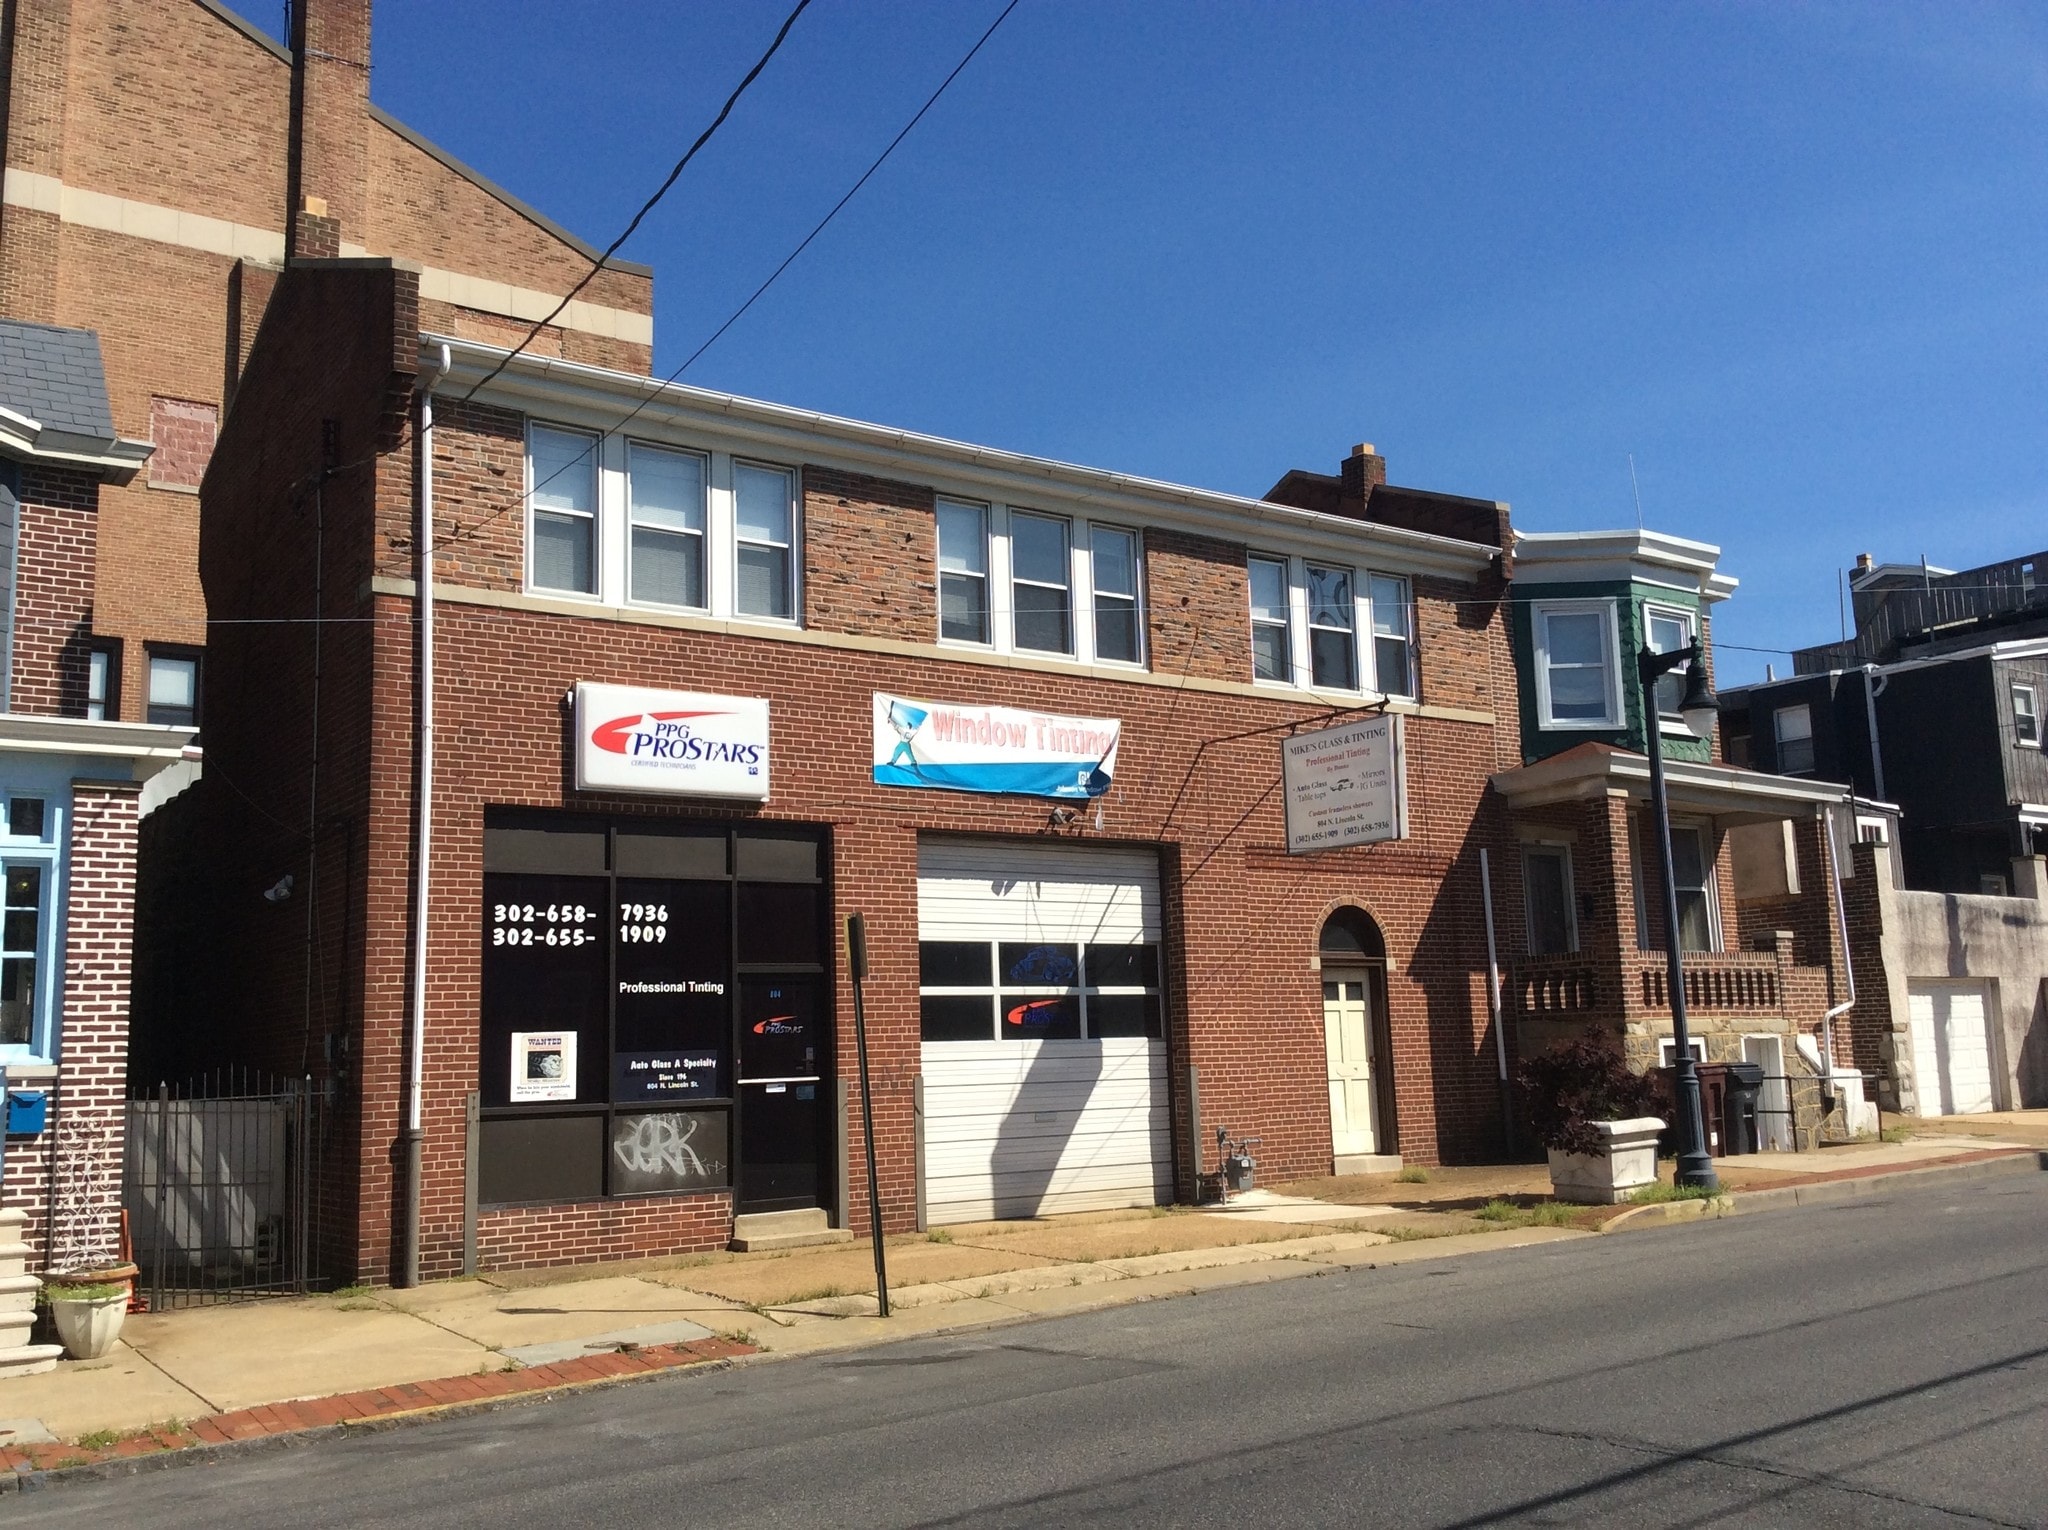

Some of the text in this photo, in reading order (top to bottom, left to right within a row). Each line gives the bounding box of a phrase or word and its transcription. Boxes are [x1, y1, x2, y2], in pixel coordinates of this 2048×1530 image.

[655, 722, 691, 739] PPG
[932, 710, 1111, 756] Window Tinting
[1290, 727, 1386, 756] MIKE'S GLASS & TINTING
[1305, 747, 1371, 767] Professional Tinting
[1296, 780, 1328, 792] Auto Glass
[1352, 800, 1374, 810] showers
[1335, 813, 1356, 824] Lincoln
[493, 903, 669, 923] 302-658- 7936
[493, 925, 667, 946] 302-655- 1909
[619, 980, 724, 995] Professional Tinting
[528, 1038, 561, 1046] WANTED
[630, 1057, 717, 1070] Auto Glass A Specialty
[668, 1081, 689, 1089] Lincoln
